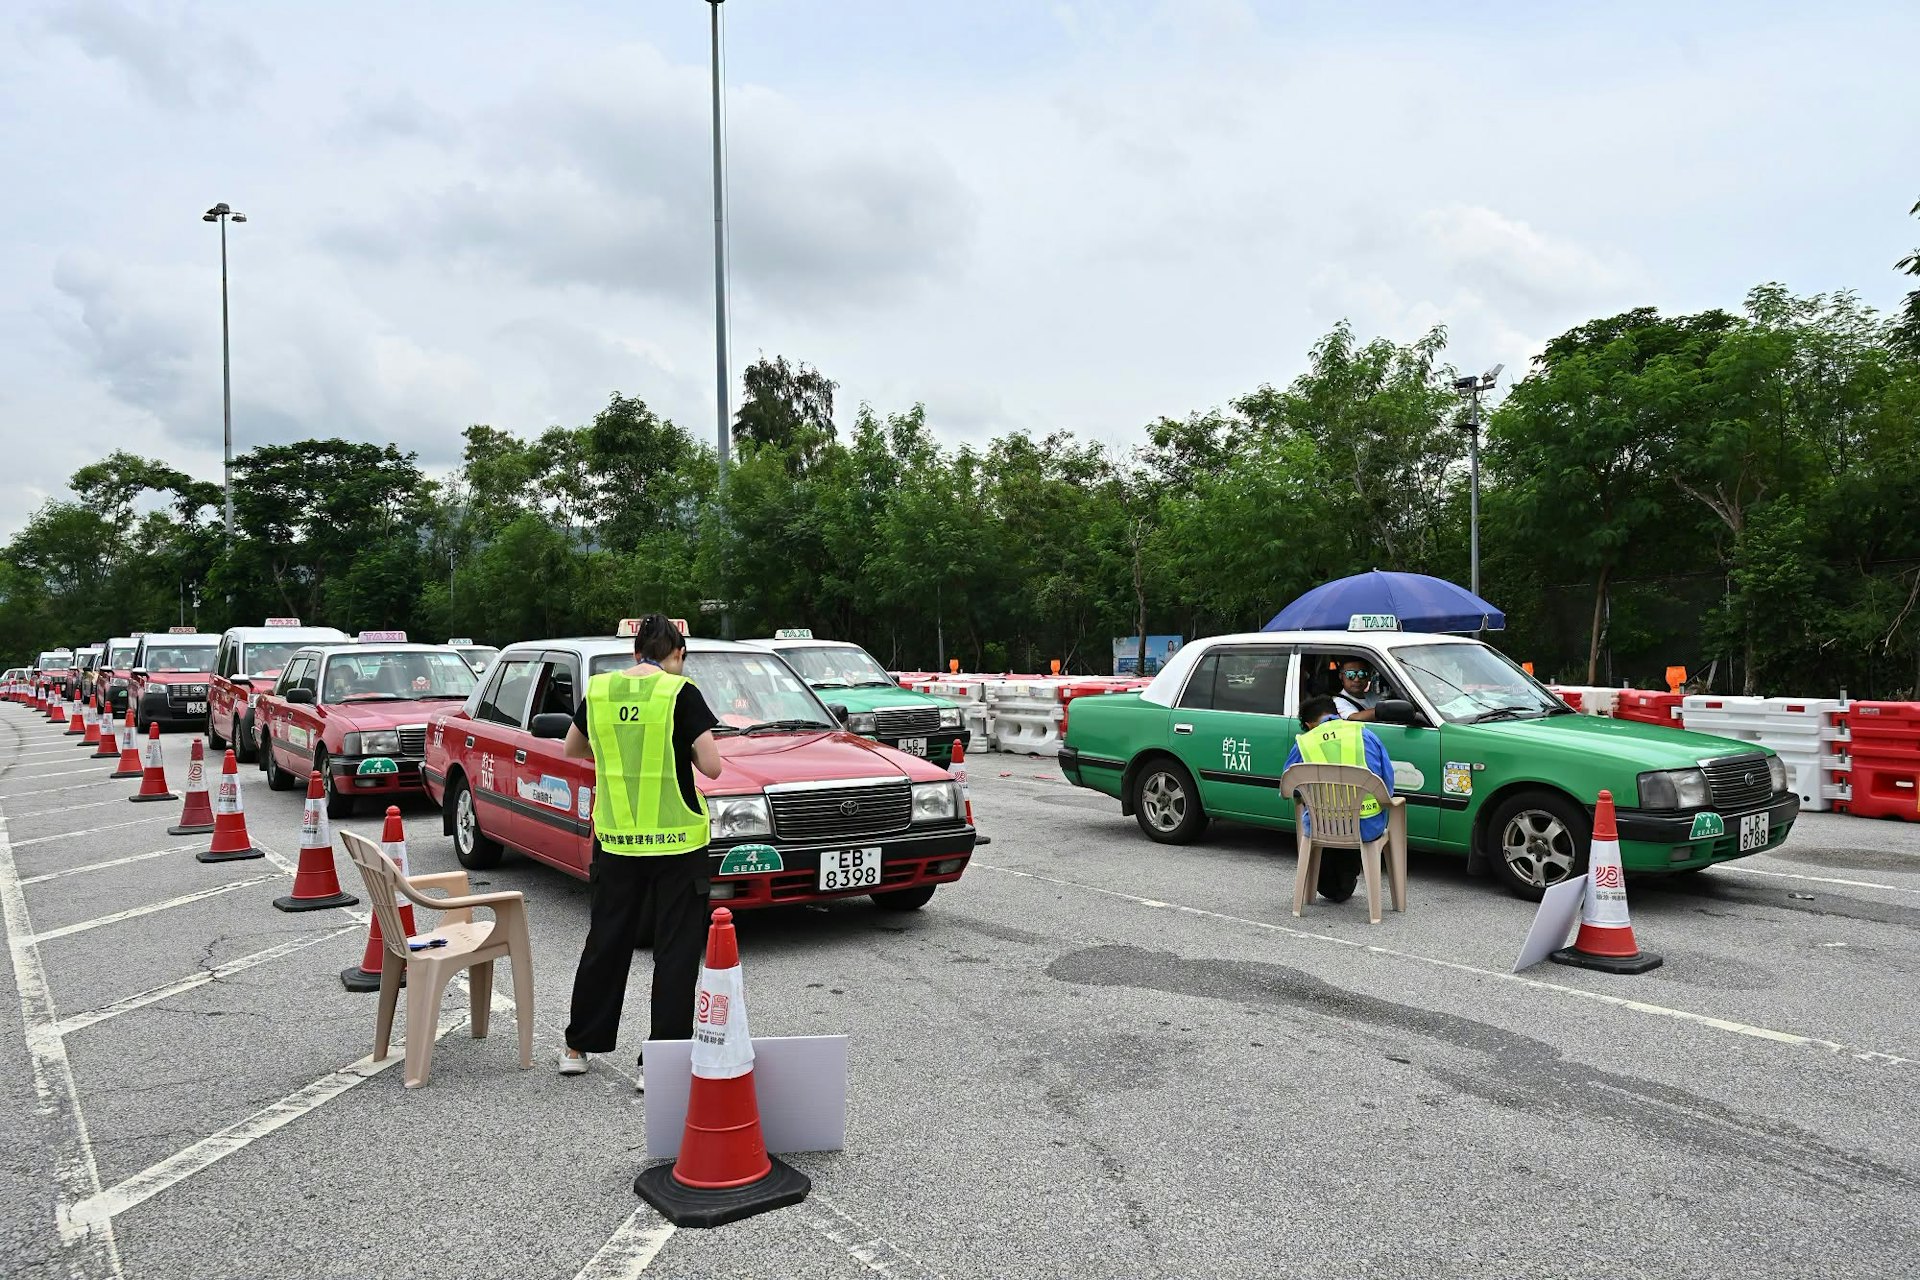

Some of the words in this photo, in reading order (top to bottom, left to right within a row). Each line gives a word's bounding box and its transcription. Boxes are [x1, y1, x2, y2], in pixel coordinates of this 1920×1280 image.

[627, 620, 684, 634] TI
[1362, 616, 1394, 628] TAXI
[363, 632, 404, 640] TAXI
[782, 629, 810, 638] TAXI
[619, 706, 639, 722] 02
[1322, 731, 1336, 741] 01
[906, 739, 919, 748] LG
[1222, 736, 1251, 755] 的士
[373, 761, 382, 769] 4
[482, 752, 495, 772] 的士
[1222, 753, 1251, 772] TAXI
[481, 769, 495, 791] TAXI
[1705, 817, 1712, 830] 4
[1749, 815, 1761, 831] LR
[1696, 827, 1719, 837] SEATS
[1743, 829, 1766, 849] 8788
[746, 850, 758, 864] 4
[839, 850, 864, 869] EB
[732, 863, 771, 872] SEATS
[826, 867, 876, 889] 8398
